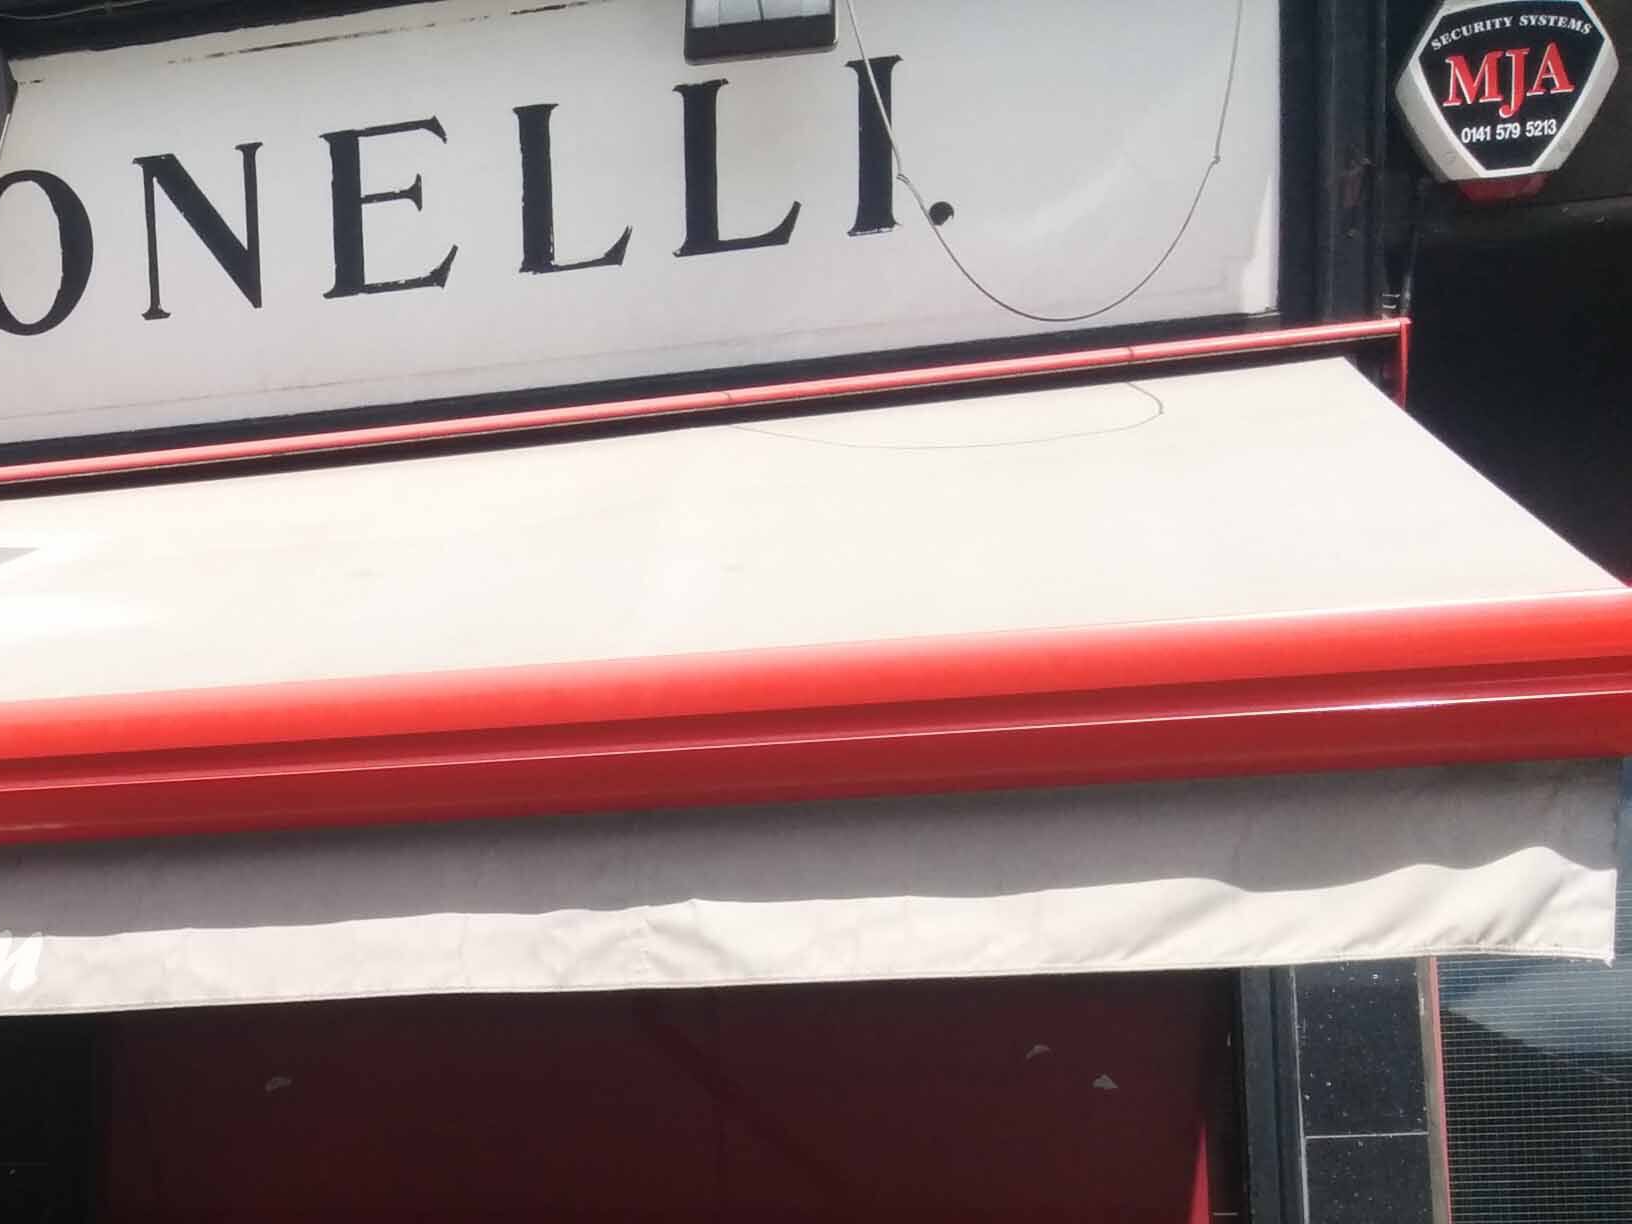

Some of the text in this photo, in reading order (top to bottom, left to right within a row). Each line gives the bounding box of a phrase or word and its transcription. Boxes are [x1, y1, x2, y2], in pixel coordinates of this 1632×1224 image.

[1431, 14, 1593, 50] SECURITY SYSTEMS
[1442, 41, 1575, 118] MJA
[1461, 120, 1557, 143] 0141 579 5213
